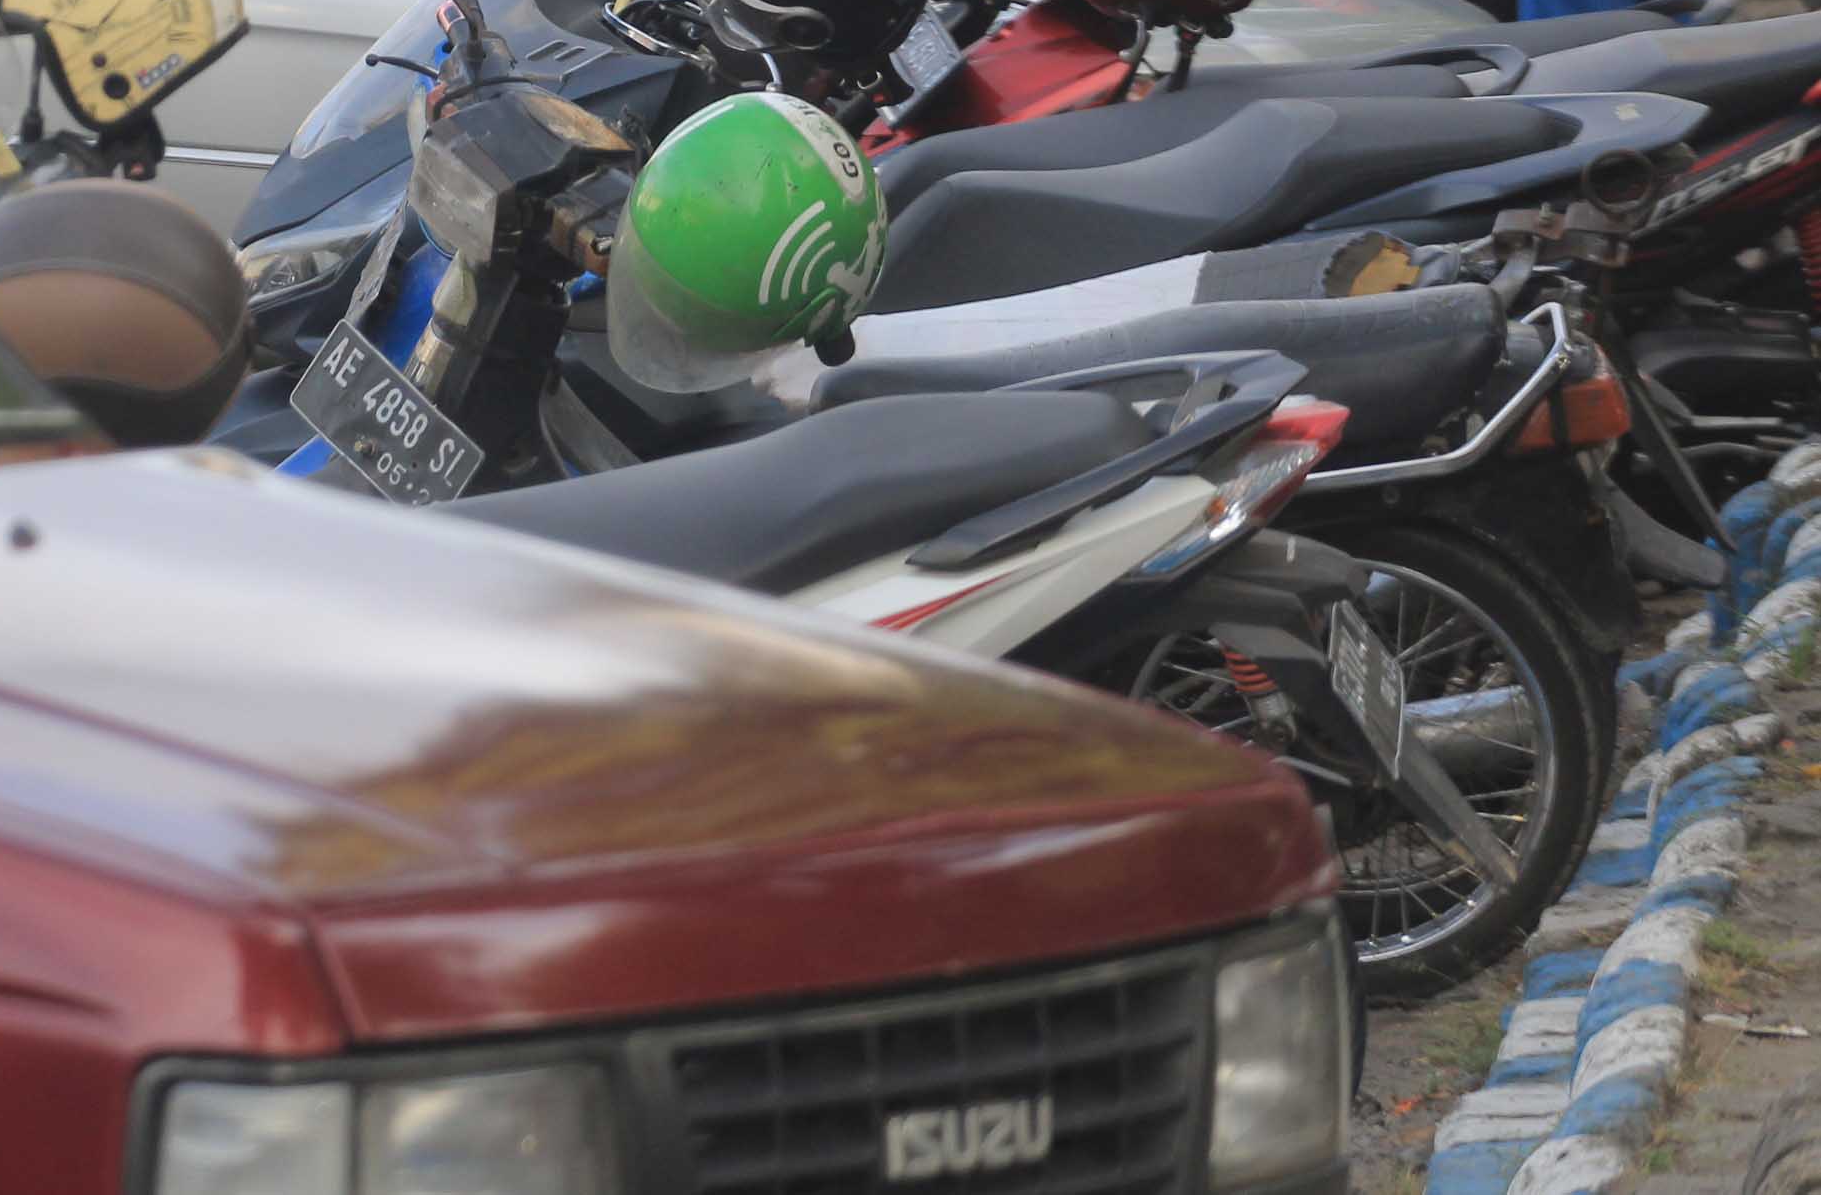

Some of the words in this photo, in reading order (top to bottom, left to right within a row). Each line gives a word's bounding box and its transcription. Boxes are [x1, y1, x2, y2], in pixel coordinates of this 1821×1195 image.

[832, 142, 859, 178] GO
[322, 337, 365, 388] AE
[362, 378, 428, 449] 4858
[429, 438, 466, 488] SL
[886, 1095, 1054, 1180] ISUZU
